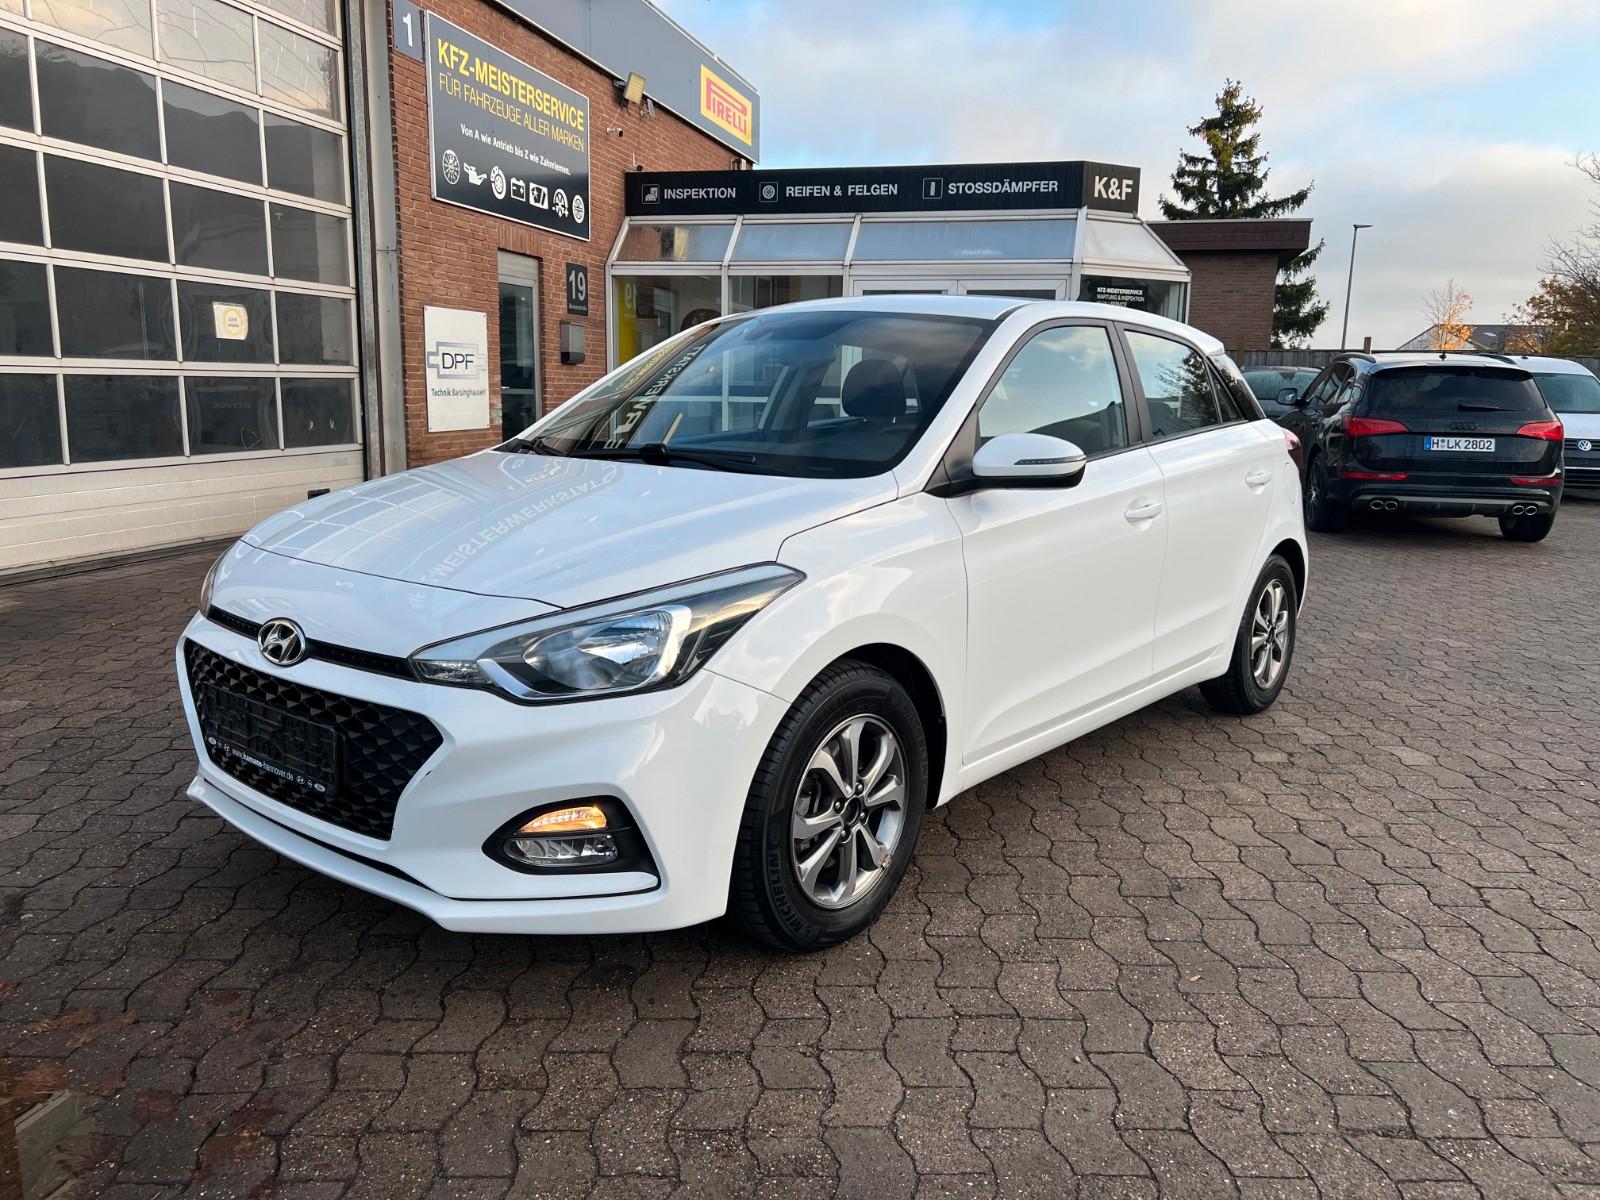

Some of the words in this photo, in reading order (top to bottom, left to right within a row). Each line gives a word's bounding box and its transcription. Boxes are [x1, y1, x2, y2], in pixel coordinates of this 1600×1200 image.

[402, 12, 413, 47] 1
[437, 38, 584, 132] KFZ-MEISTERSERVICE
[439, 72, 462, 100] FÜR
[464, 84, 522, 126] FAHRZEUGE
[523, 113, 550, 137] ALLER
[551, 124, 584, 152] MARKEN
[706, 77, 748, 137] PIRELLI
[460, 124, 474, 139] Von
[474, 128, 480, 140] A
[480, 133, 492, 146] wie
[493, 137, 514, 154] Antrieb
[514, 145, 524, 157] bis
[524, 148, 529, 160] Z
[529, 153, 540, 164] wie
[664, 187, 736, 200] INSPEKTION
[785, 185, 831, 198] REIFEN
[834, 184, 843, 197] &
[847, 183, 898, 196] FELGEN
[948, 178, 1059, 195] STOSSDÄMPFER
[1094, 175, 1133, 201] K&F
[569, 270, 586, 302] 19
[442, 353, 474, 370] DPF
[431, 388, 451, 397] Technik
[1432, 438, 1439, 449] H
[1446, 439, 1461, 449] LK
[1464, 439, 1493, 450] 2802
[768, 847, 807, 933] MICHELIN
